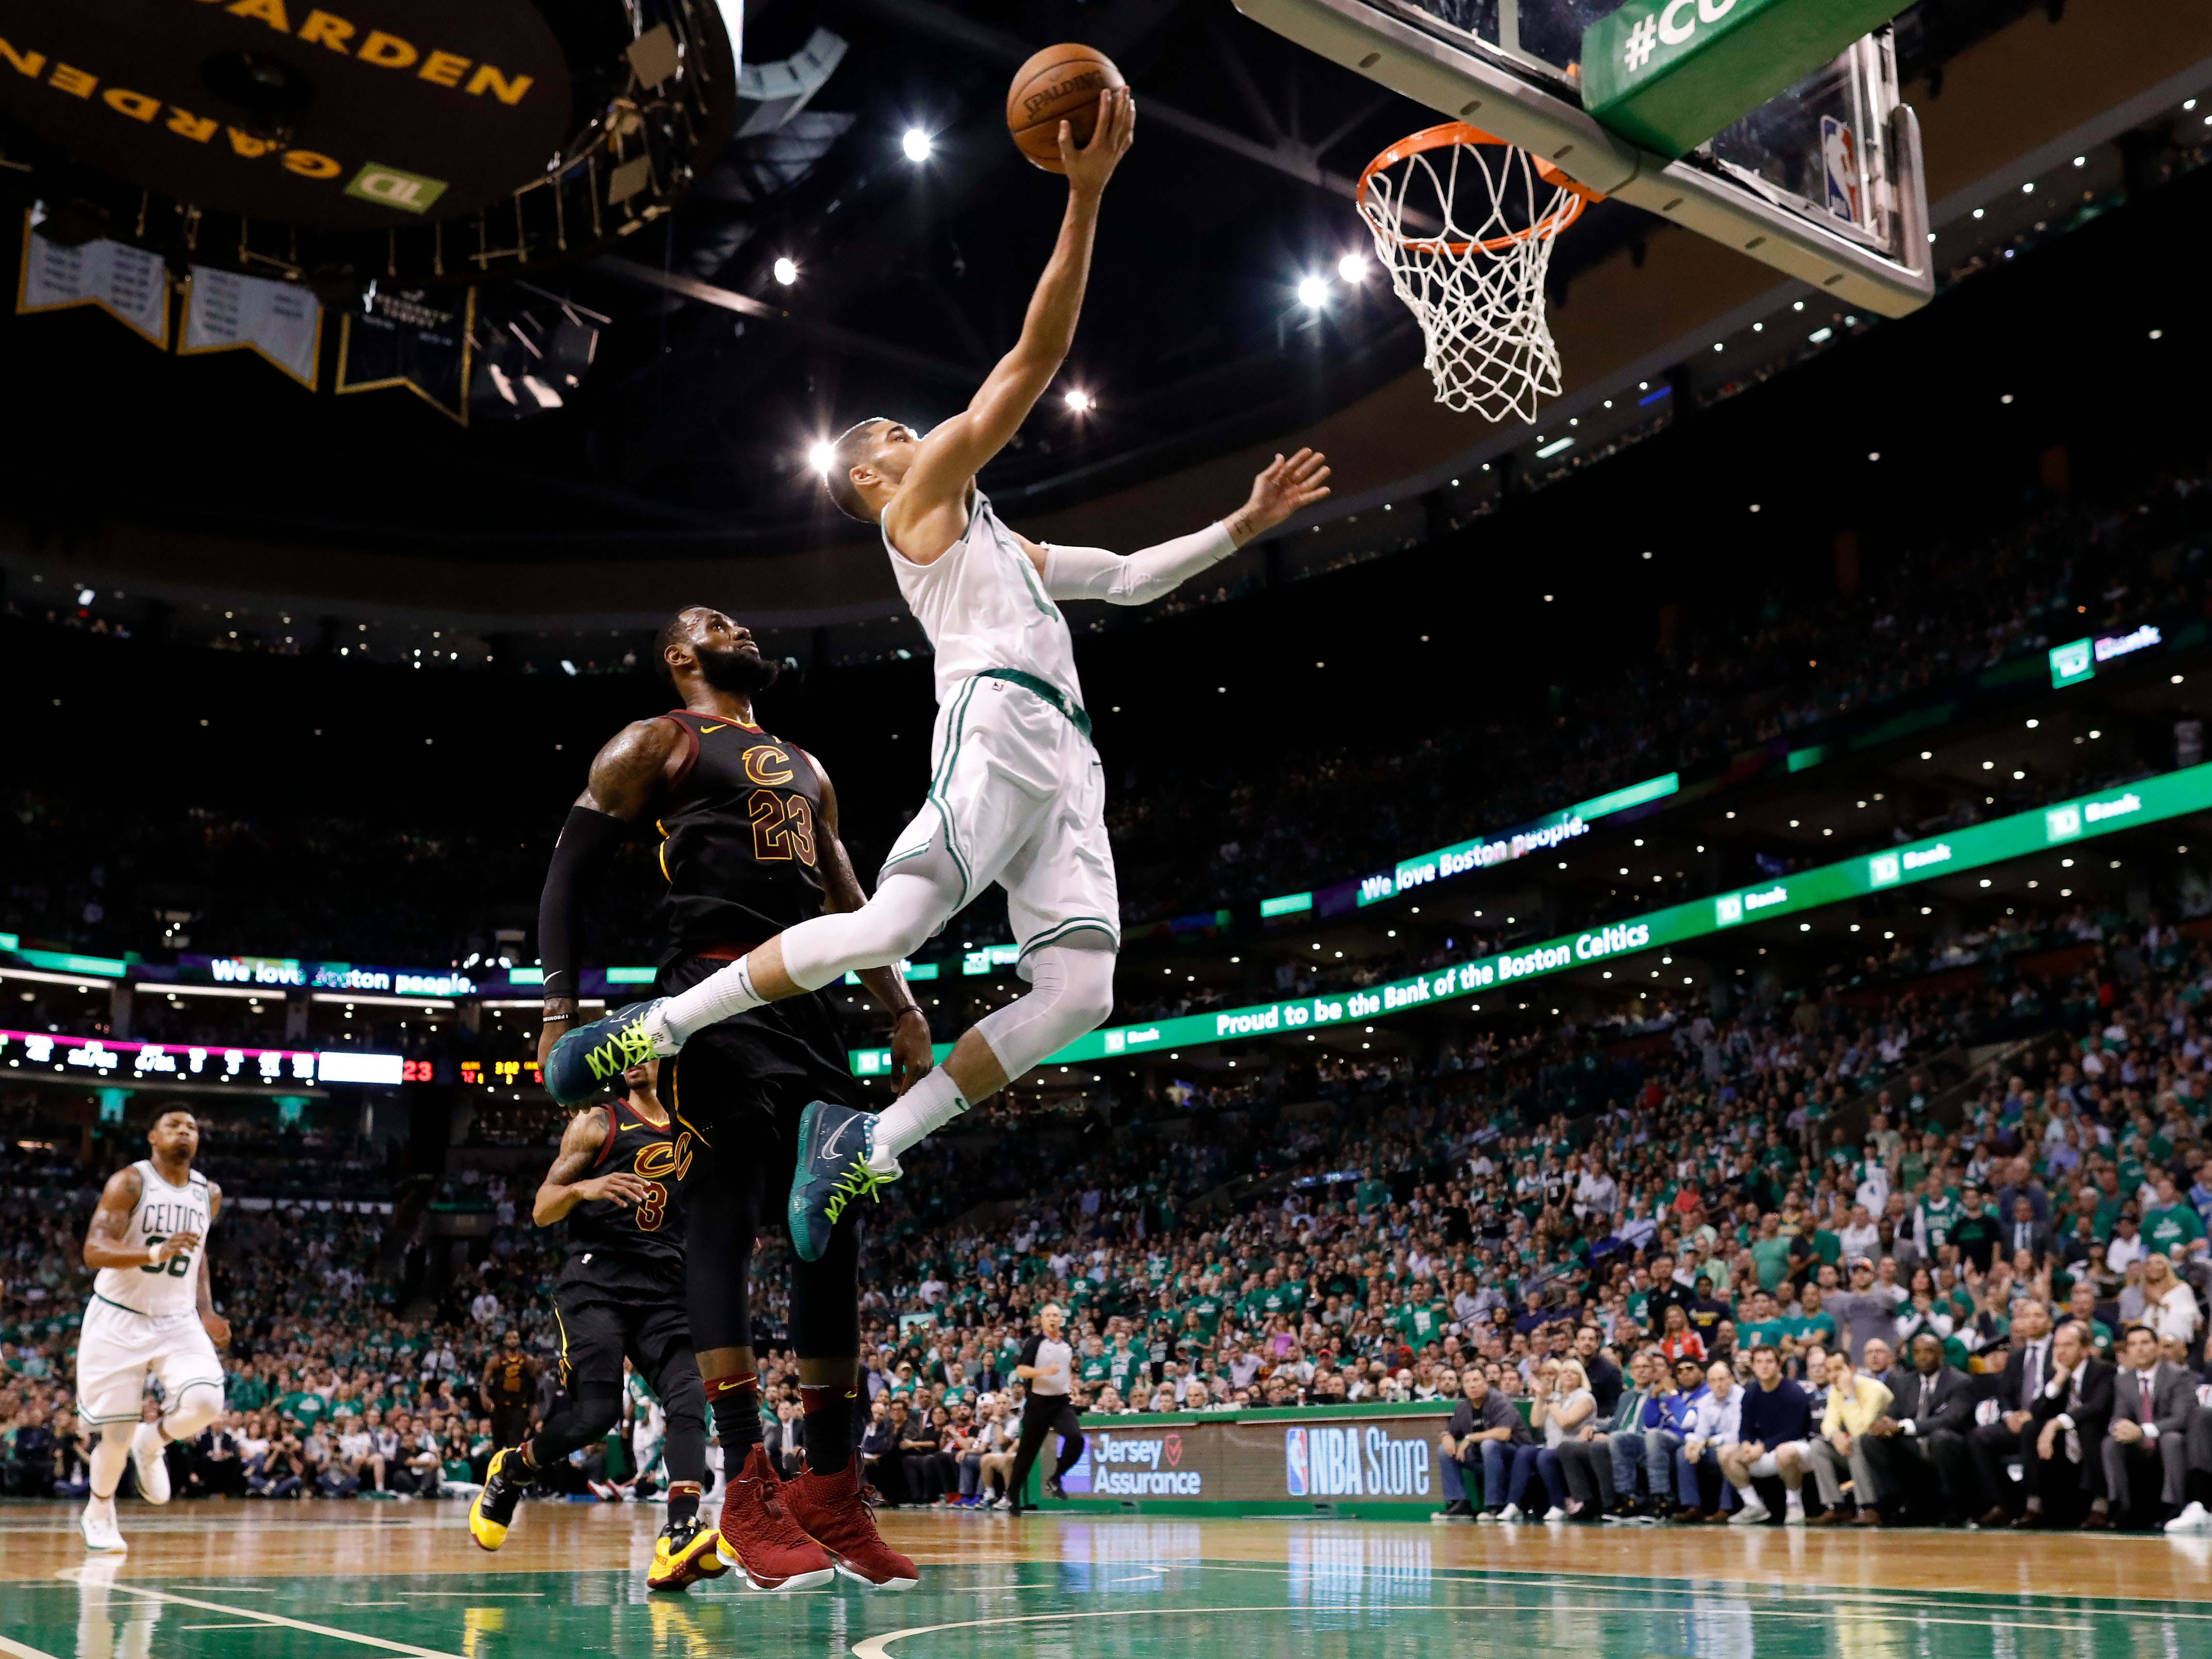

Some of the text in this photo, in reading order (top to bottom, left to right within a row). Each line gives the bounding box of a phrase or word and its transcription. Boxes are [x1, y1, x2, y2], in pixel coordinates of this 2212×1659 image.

[204, 0, 534, 106] ARDEN
[1023, 70, 1104, 121] SPALDING
[360, 172, 424, 205] TD
[741, 745, 793, 785] C
[748, 789, 816, 867] 23
[1361, 813, 1590, 901] We love Boston people.
[211, 959, 251, 982] We
[395, 972, 478, 996] people.
[1217, 923, 1649, 1036] Proud to be the Bank of the Boston Celtics
[142, 1203, 206, 1241] CELTICS
[635, 1181, 668, 1231] 3
[1094, 1433, 1163, 1471] Jersey
[1309, 1425, 1430, 1496] NBA Store
[1093, 1464, 1202, 1495] Assurance
